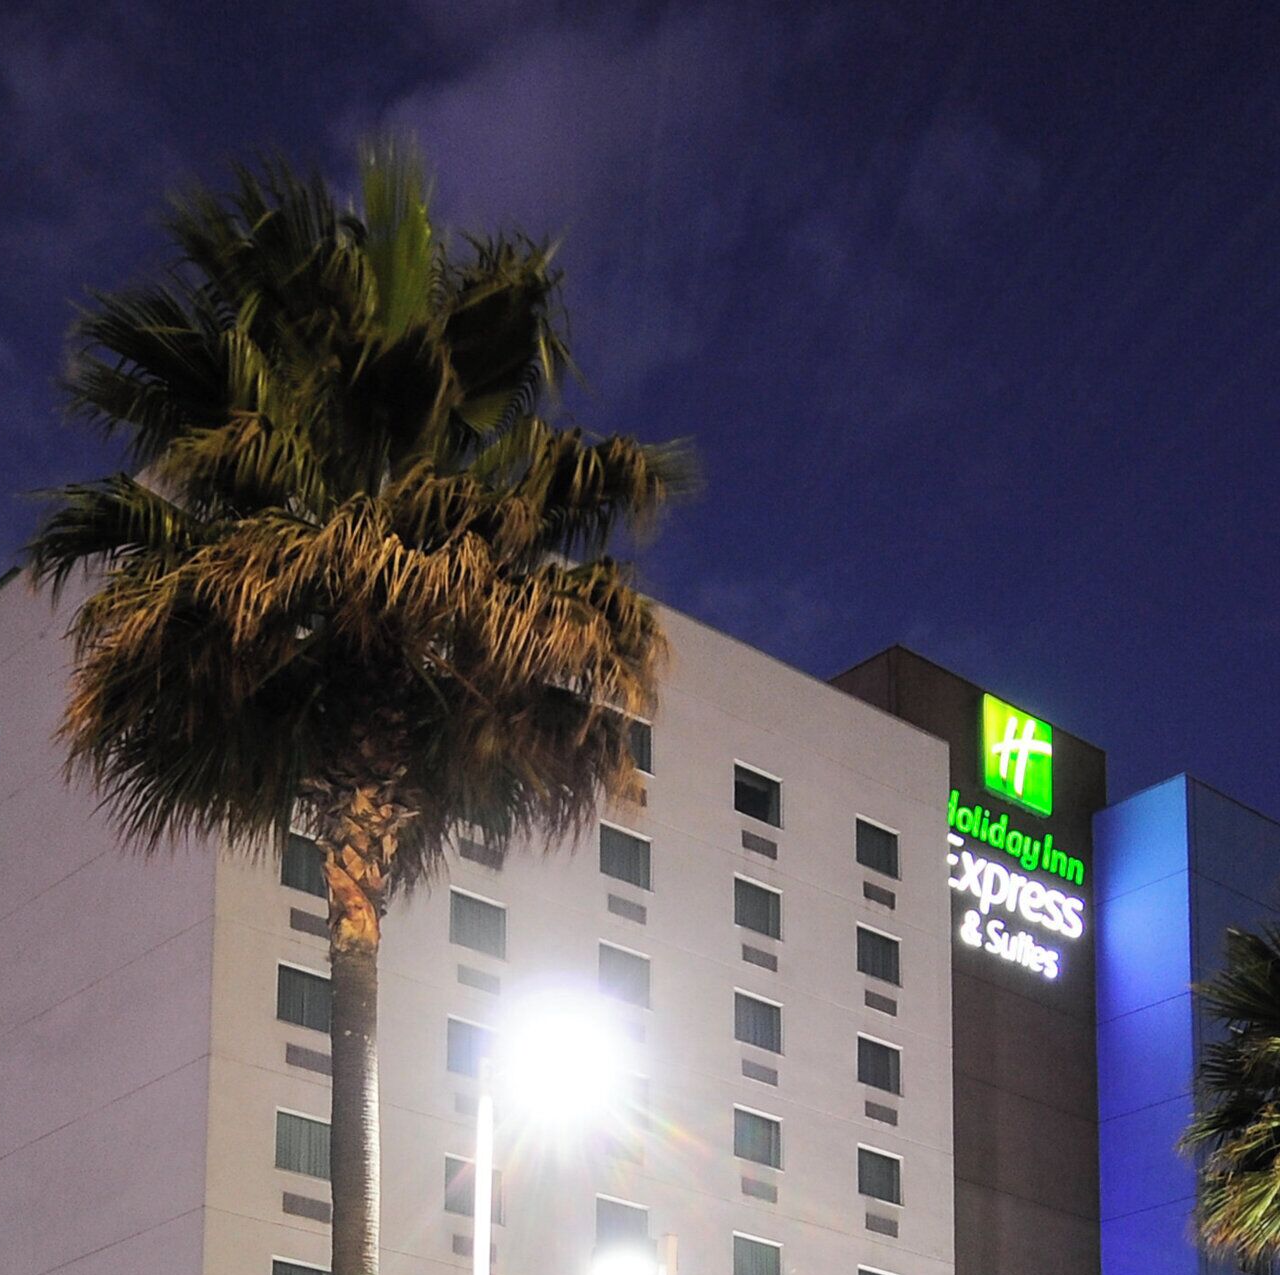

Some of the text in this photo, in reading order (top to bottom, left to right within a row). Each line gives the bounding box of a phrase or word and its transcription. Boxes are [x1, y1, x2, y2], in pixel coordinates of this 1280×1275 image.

[1042, 833, 1085, 886] Inn
[960, 909, 1059, 979] & Suites
